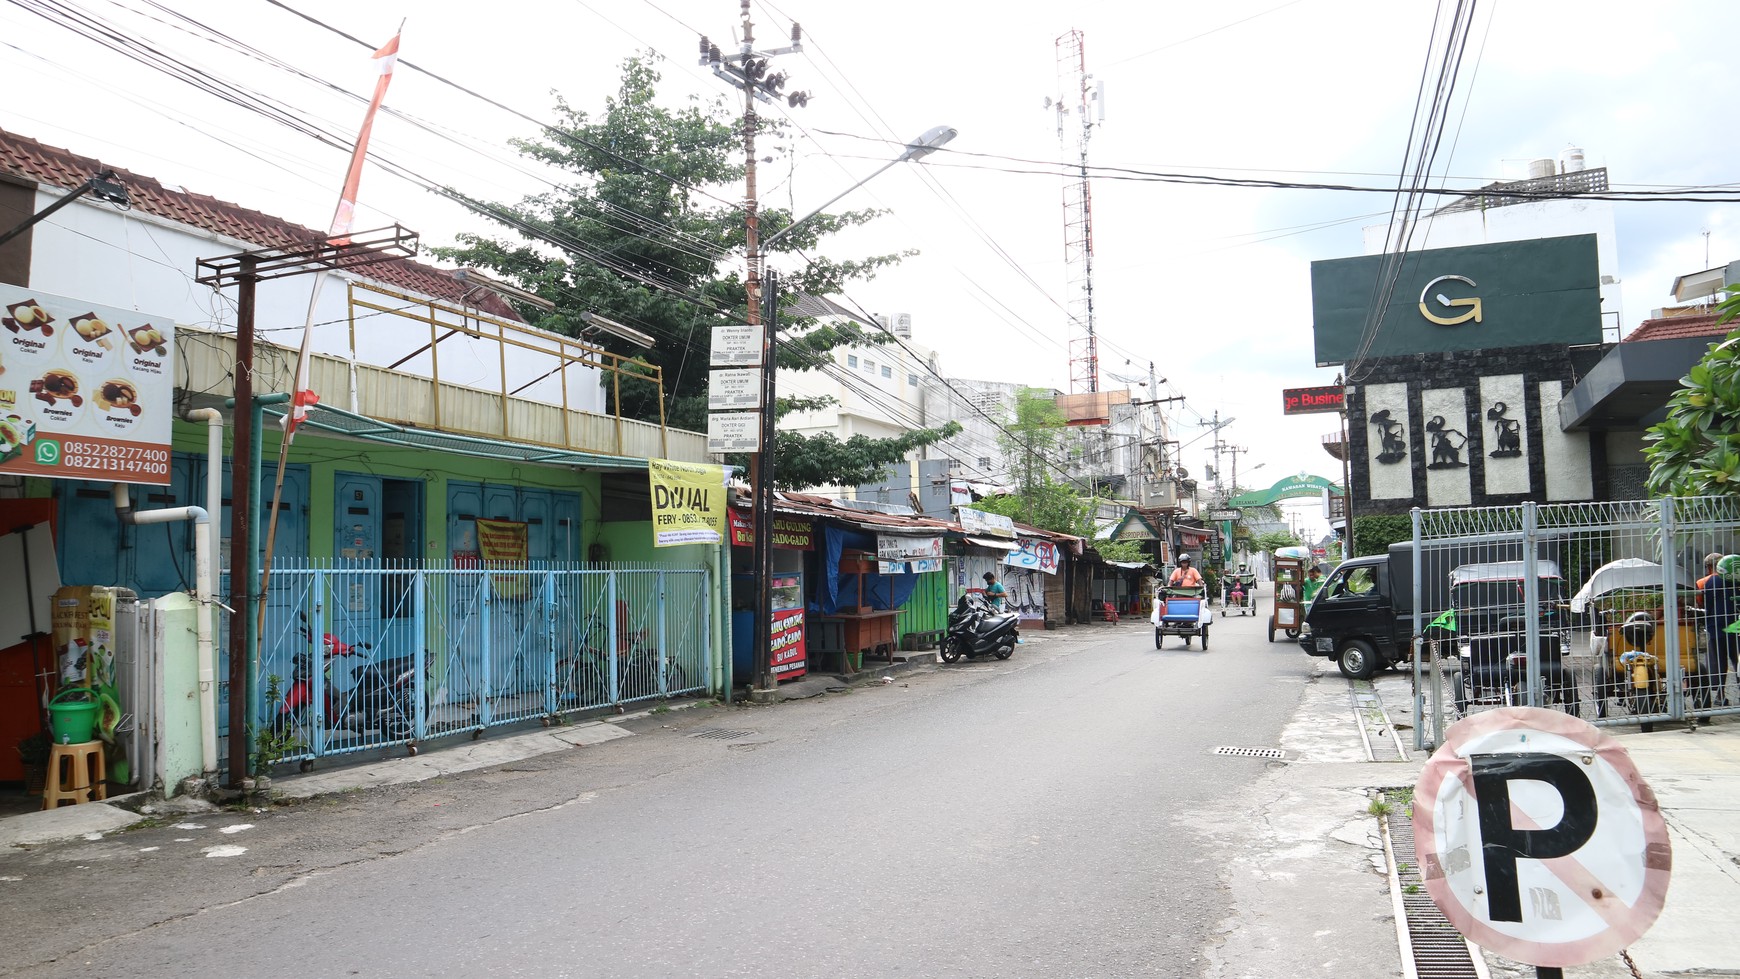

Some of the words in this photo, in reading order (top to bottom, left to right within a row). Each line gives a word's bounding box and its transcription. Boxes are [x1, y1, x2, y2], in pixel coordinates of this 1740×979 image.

[12, 337, 46, 349] Original
[19, 346, 38, 355] Coklat
[72, 347, 103, 360] Original
[133, 358, 162, 369] Original
[43, 407, 73, 417] Brownies
[50, 415, 67, 423] Coklat
[106, 415, 133, 425] Brownies
[64, 441, 168, 462] 085228277400
[64, 455, 168, 475] 082213147400
[651, 461, 663, 471] Ray
[657, 514, 677, 526] FERY
[1470, 752, 1598, 923] P
